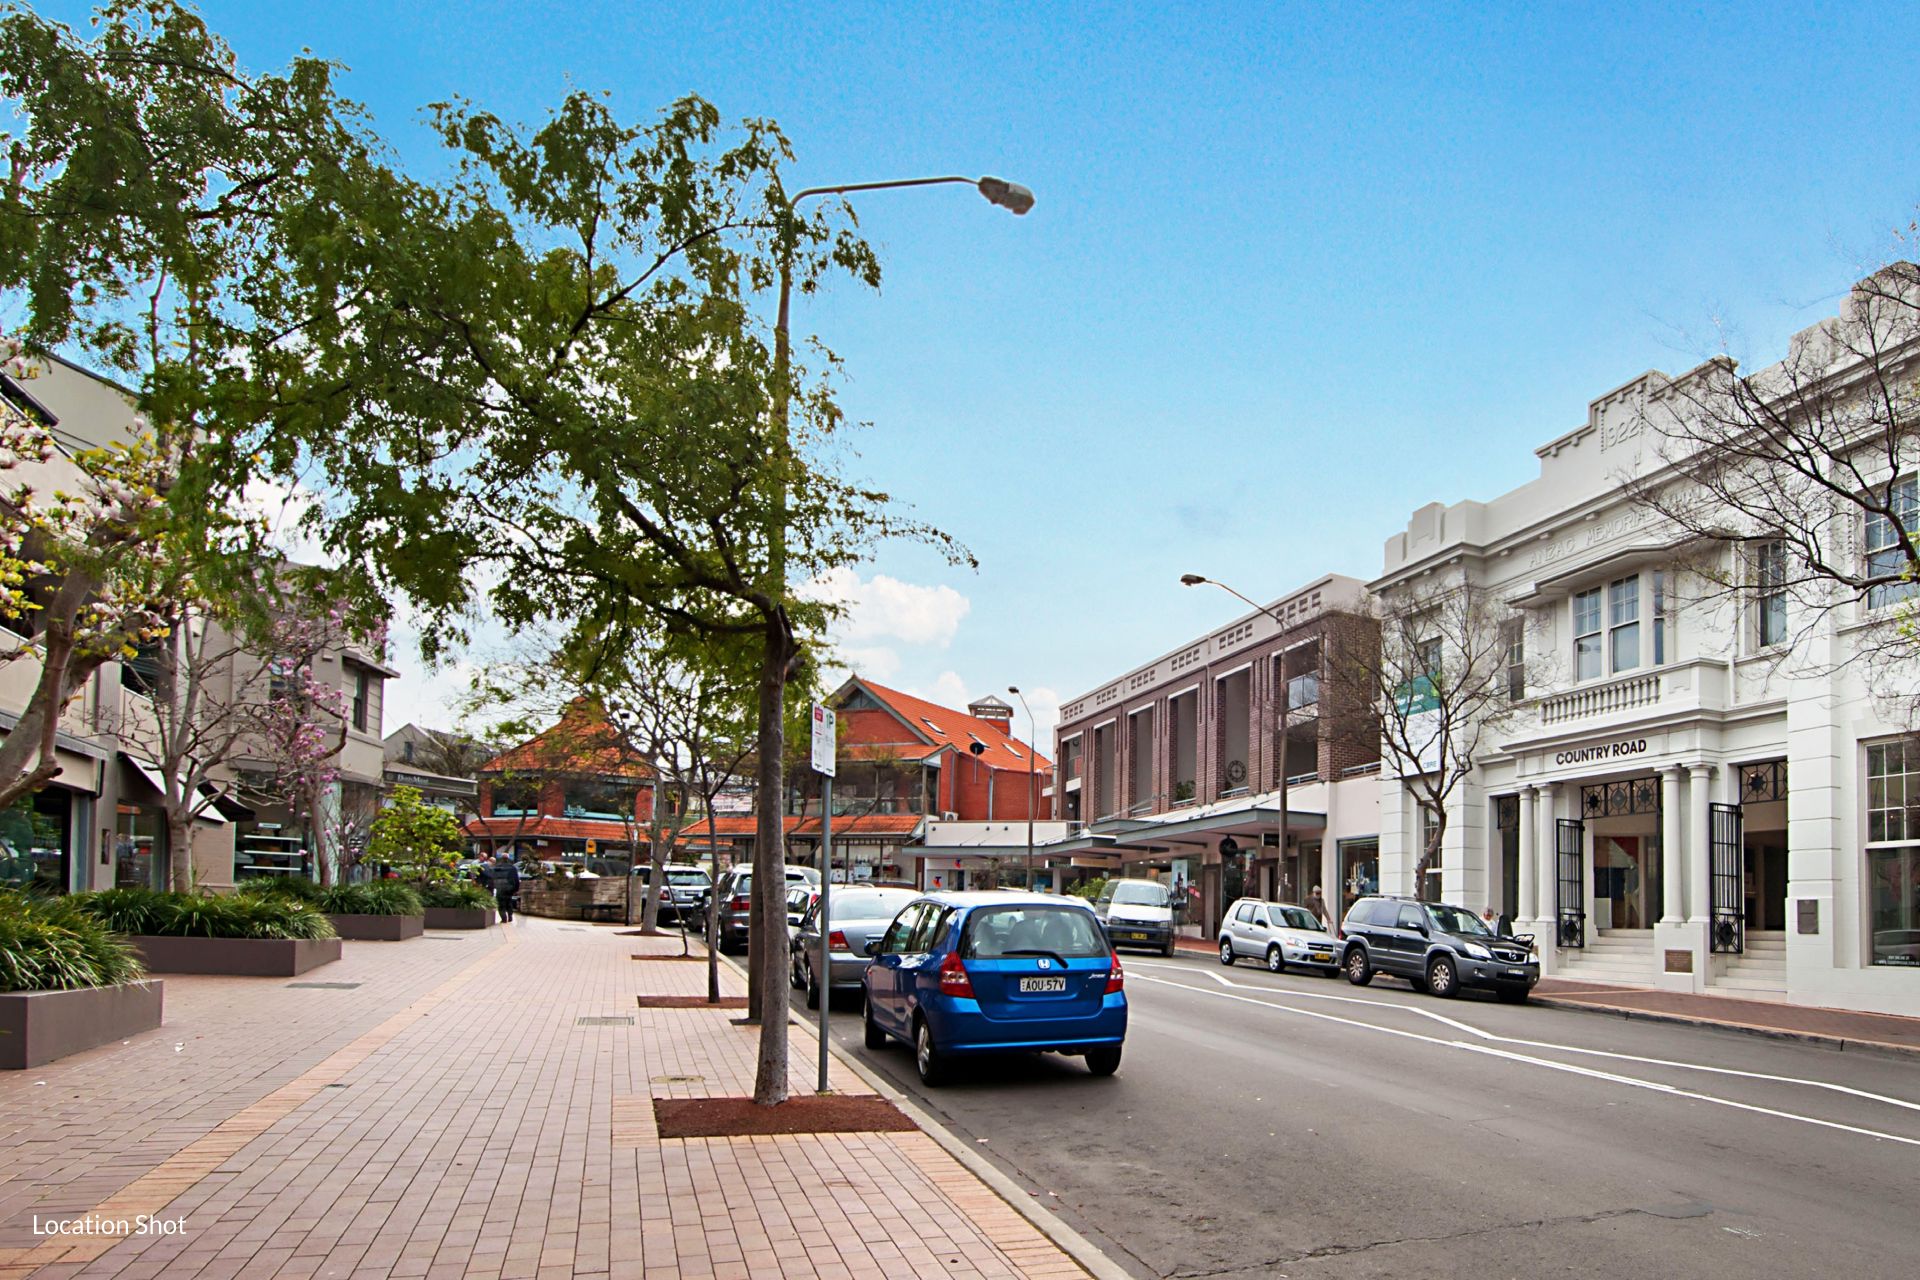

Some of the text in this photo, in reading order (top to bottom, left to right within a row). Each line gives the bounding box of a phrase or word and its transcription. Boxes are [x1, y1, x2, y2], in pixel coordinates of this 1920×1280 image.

[1604, 416, 1640, 450] 1922
[1529, 537, 1576, 568] ANZAC
[1586, 508, 1657, 546] MEMORIAL
[1556, 739, 1647, 765] COUNTRY ROAD
